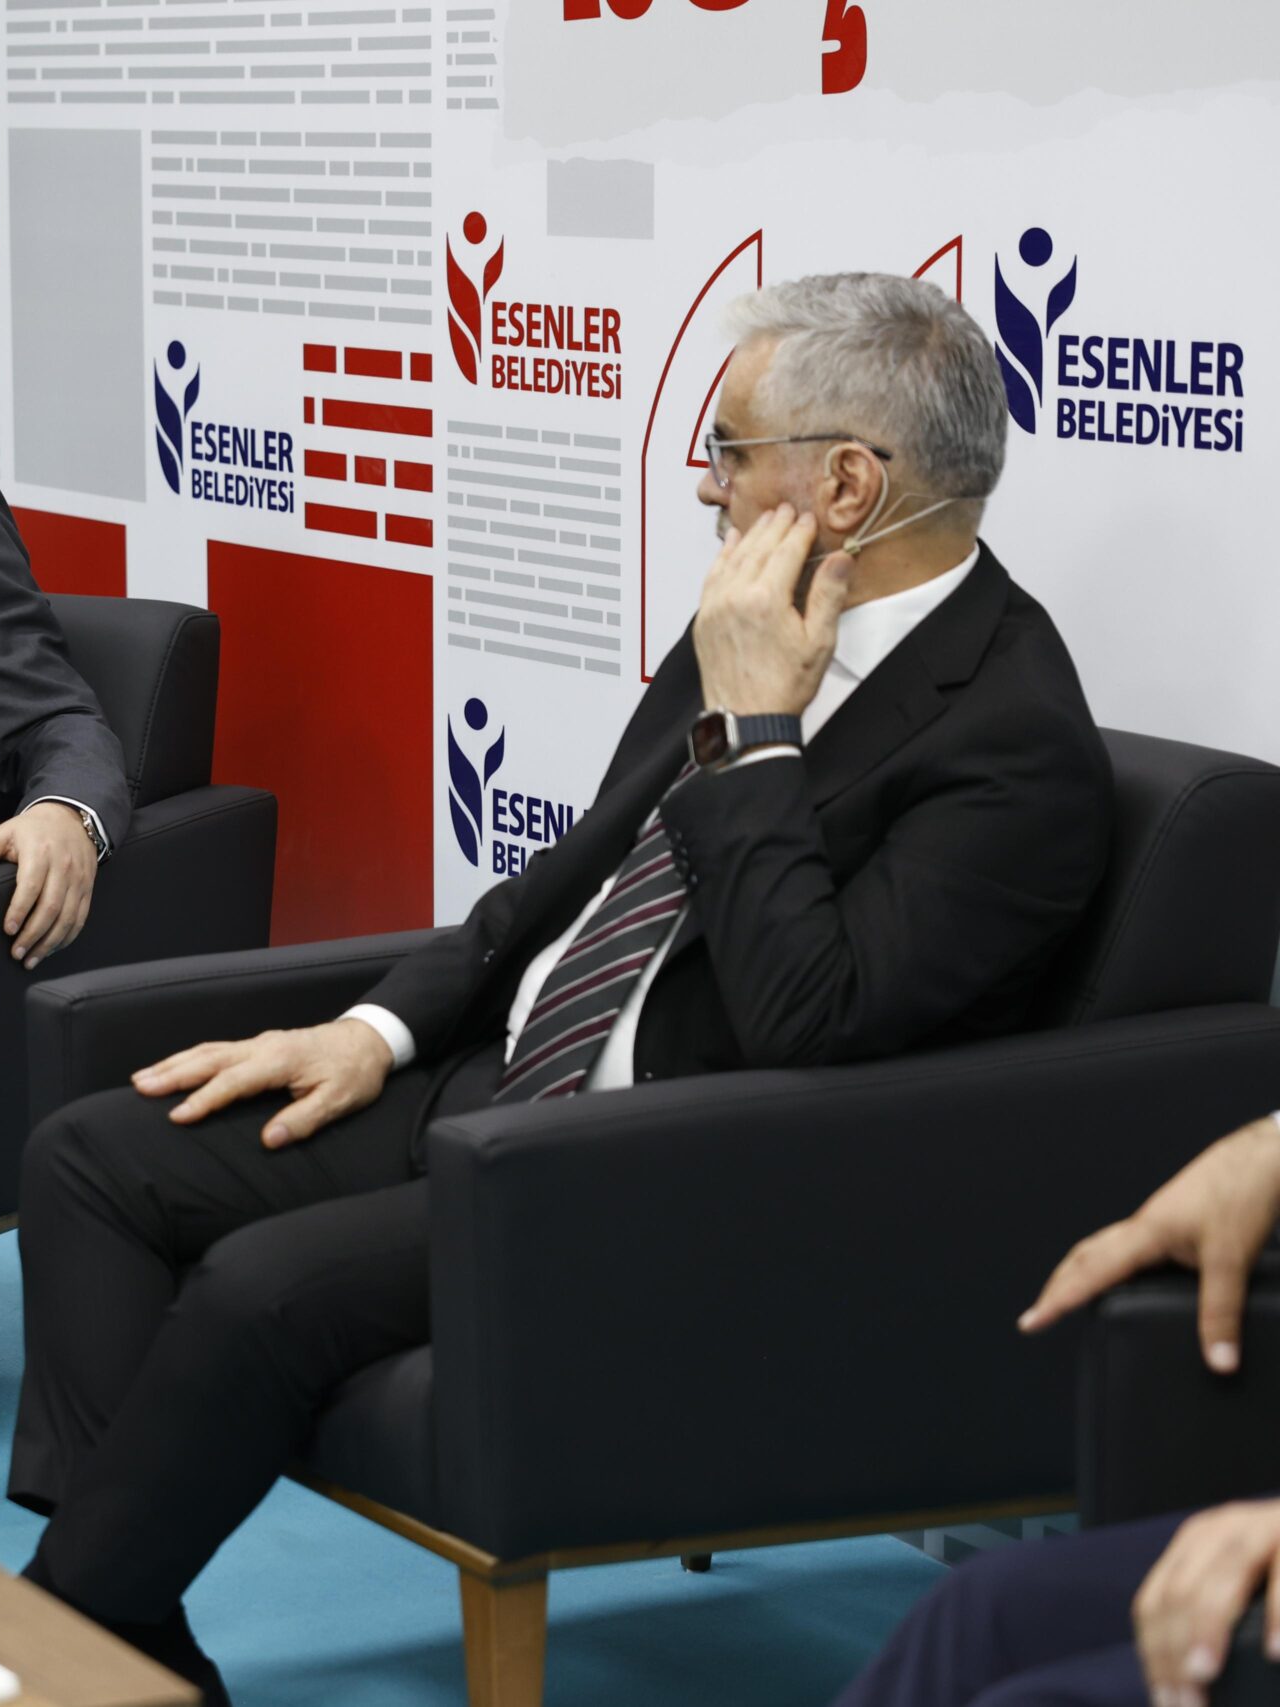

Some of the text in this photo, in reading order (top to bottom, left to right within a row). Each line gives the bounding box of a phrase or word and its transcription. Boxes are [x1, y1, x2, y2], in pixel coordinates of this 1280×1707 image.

[491, 301, 621, 354] ESENLER
[1057, 334, 1245, 398] ESENLER
[190, 421, 294, 474] ESENLER
[492, 788, 586, 844] ESEN
